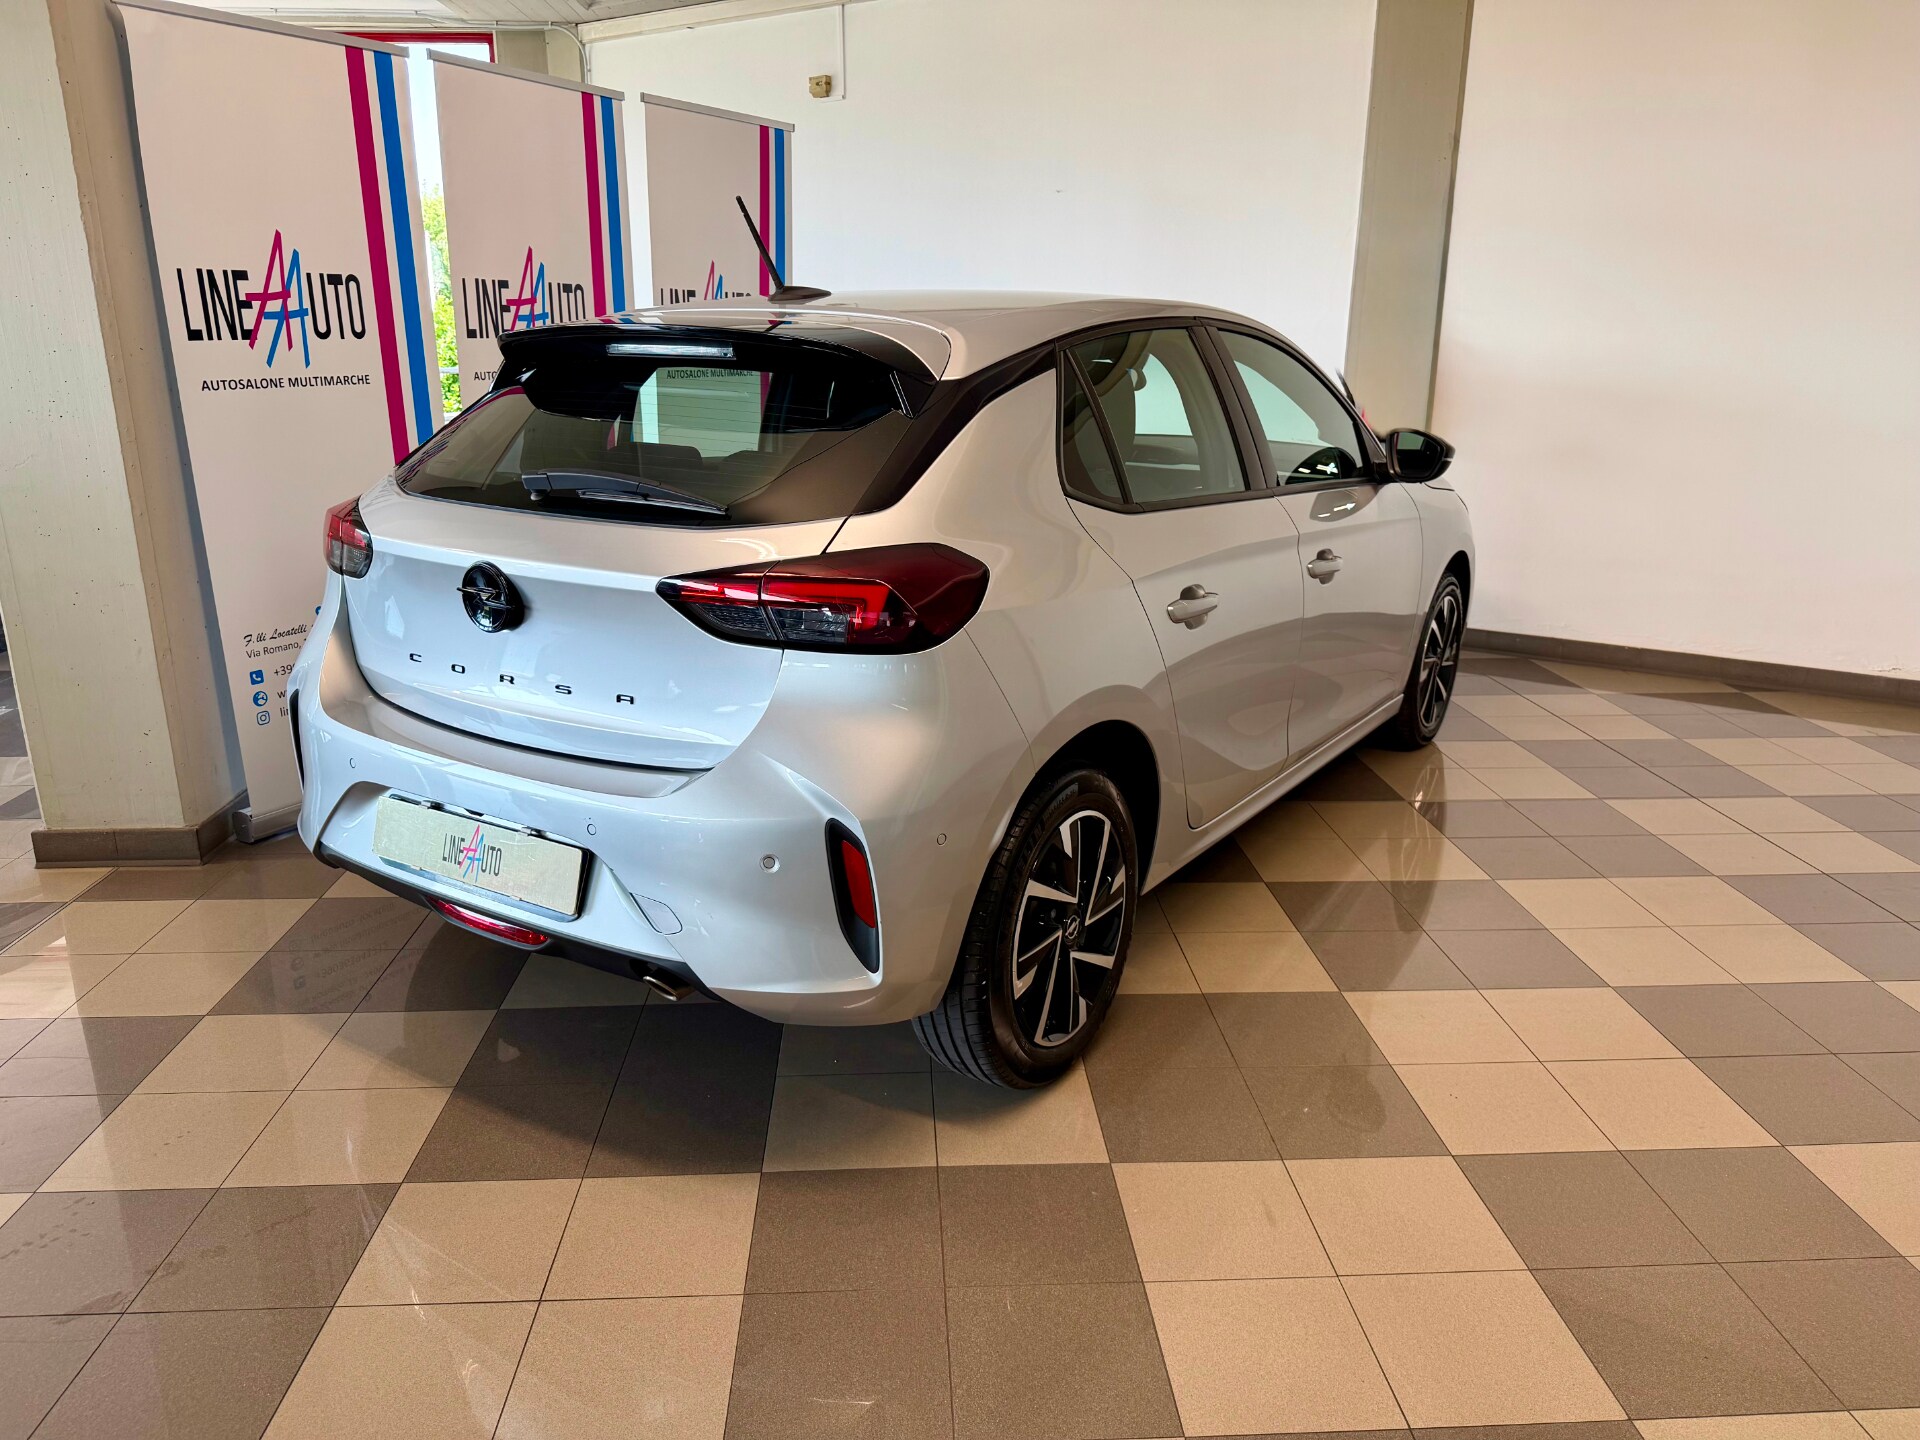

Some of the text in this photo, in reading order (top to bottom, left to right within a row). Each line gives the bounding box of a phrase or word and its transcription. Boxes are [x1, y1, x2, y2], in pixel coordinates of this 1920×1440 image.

[201, 374, 371, 392] AUTOSALONE MULTIMARCHE
[269, 624, 307, 640] Locatelli
[246, 641, 301, 659] Via Romano,
[409, 653, 635, 705] CORSA
